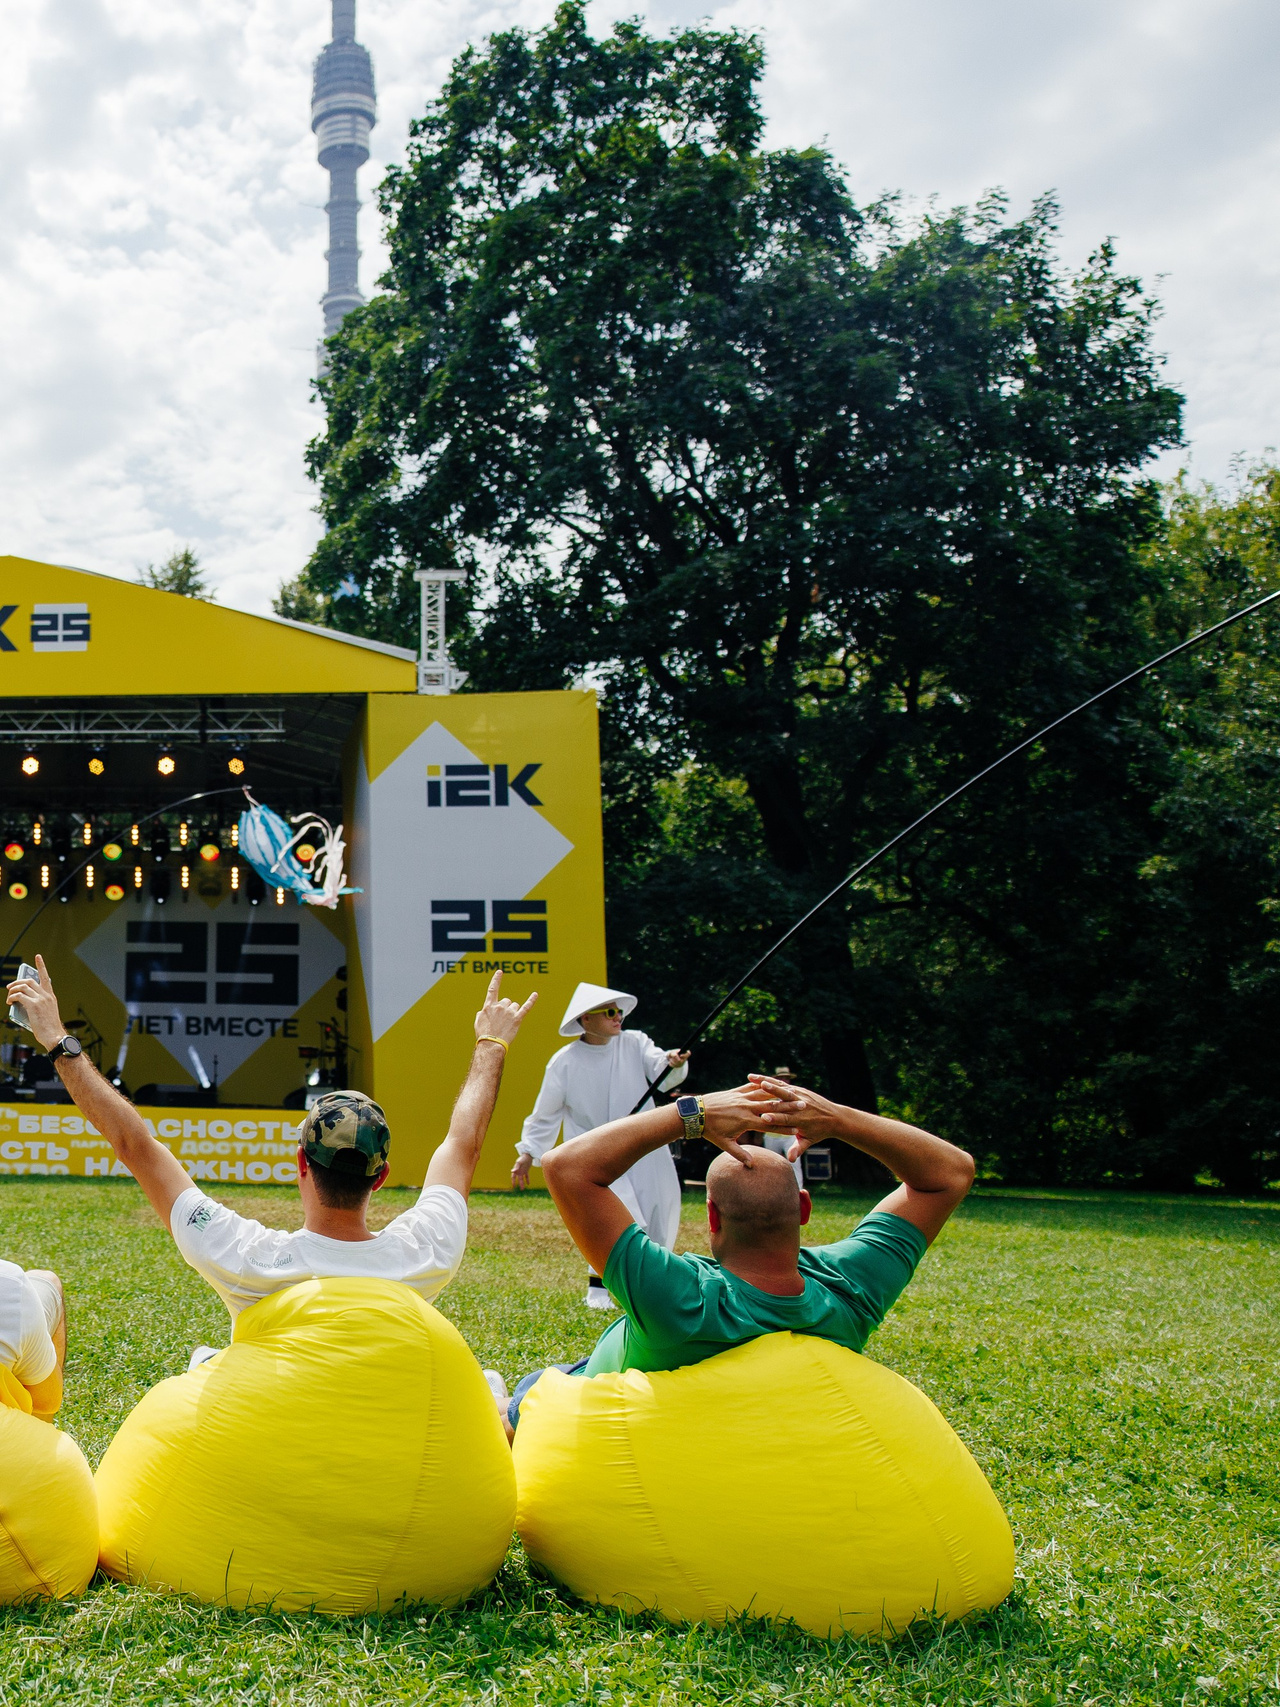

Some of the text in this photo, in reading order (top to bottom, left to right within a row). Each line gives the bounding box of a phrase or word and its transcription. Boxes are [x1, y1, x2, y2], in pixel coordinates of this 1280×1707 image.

[30, 612, 91, 643] 25
[431, 899, 549, 953] 25
[125, 921, 300, 1006] 25
[432, 960, 549, 974] ЛЕТ ВМЕСТЕ
[127, 1015, 299, 1038] ЛЕТ ВМЕСТЕ
[180, 1140, 298, 1156] ДОСТУПН
